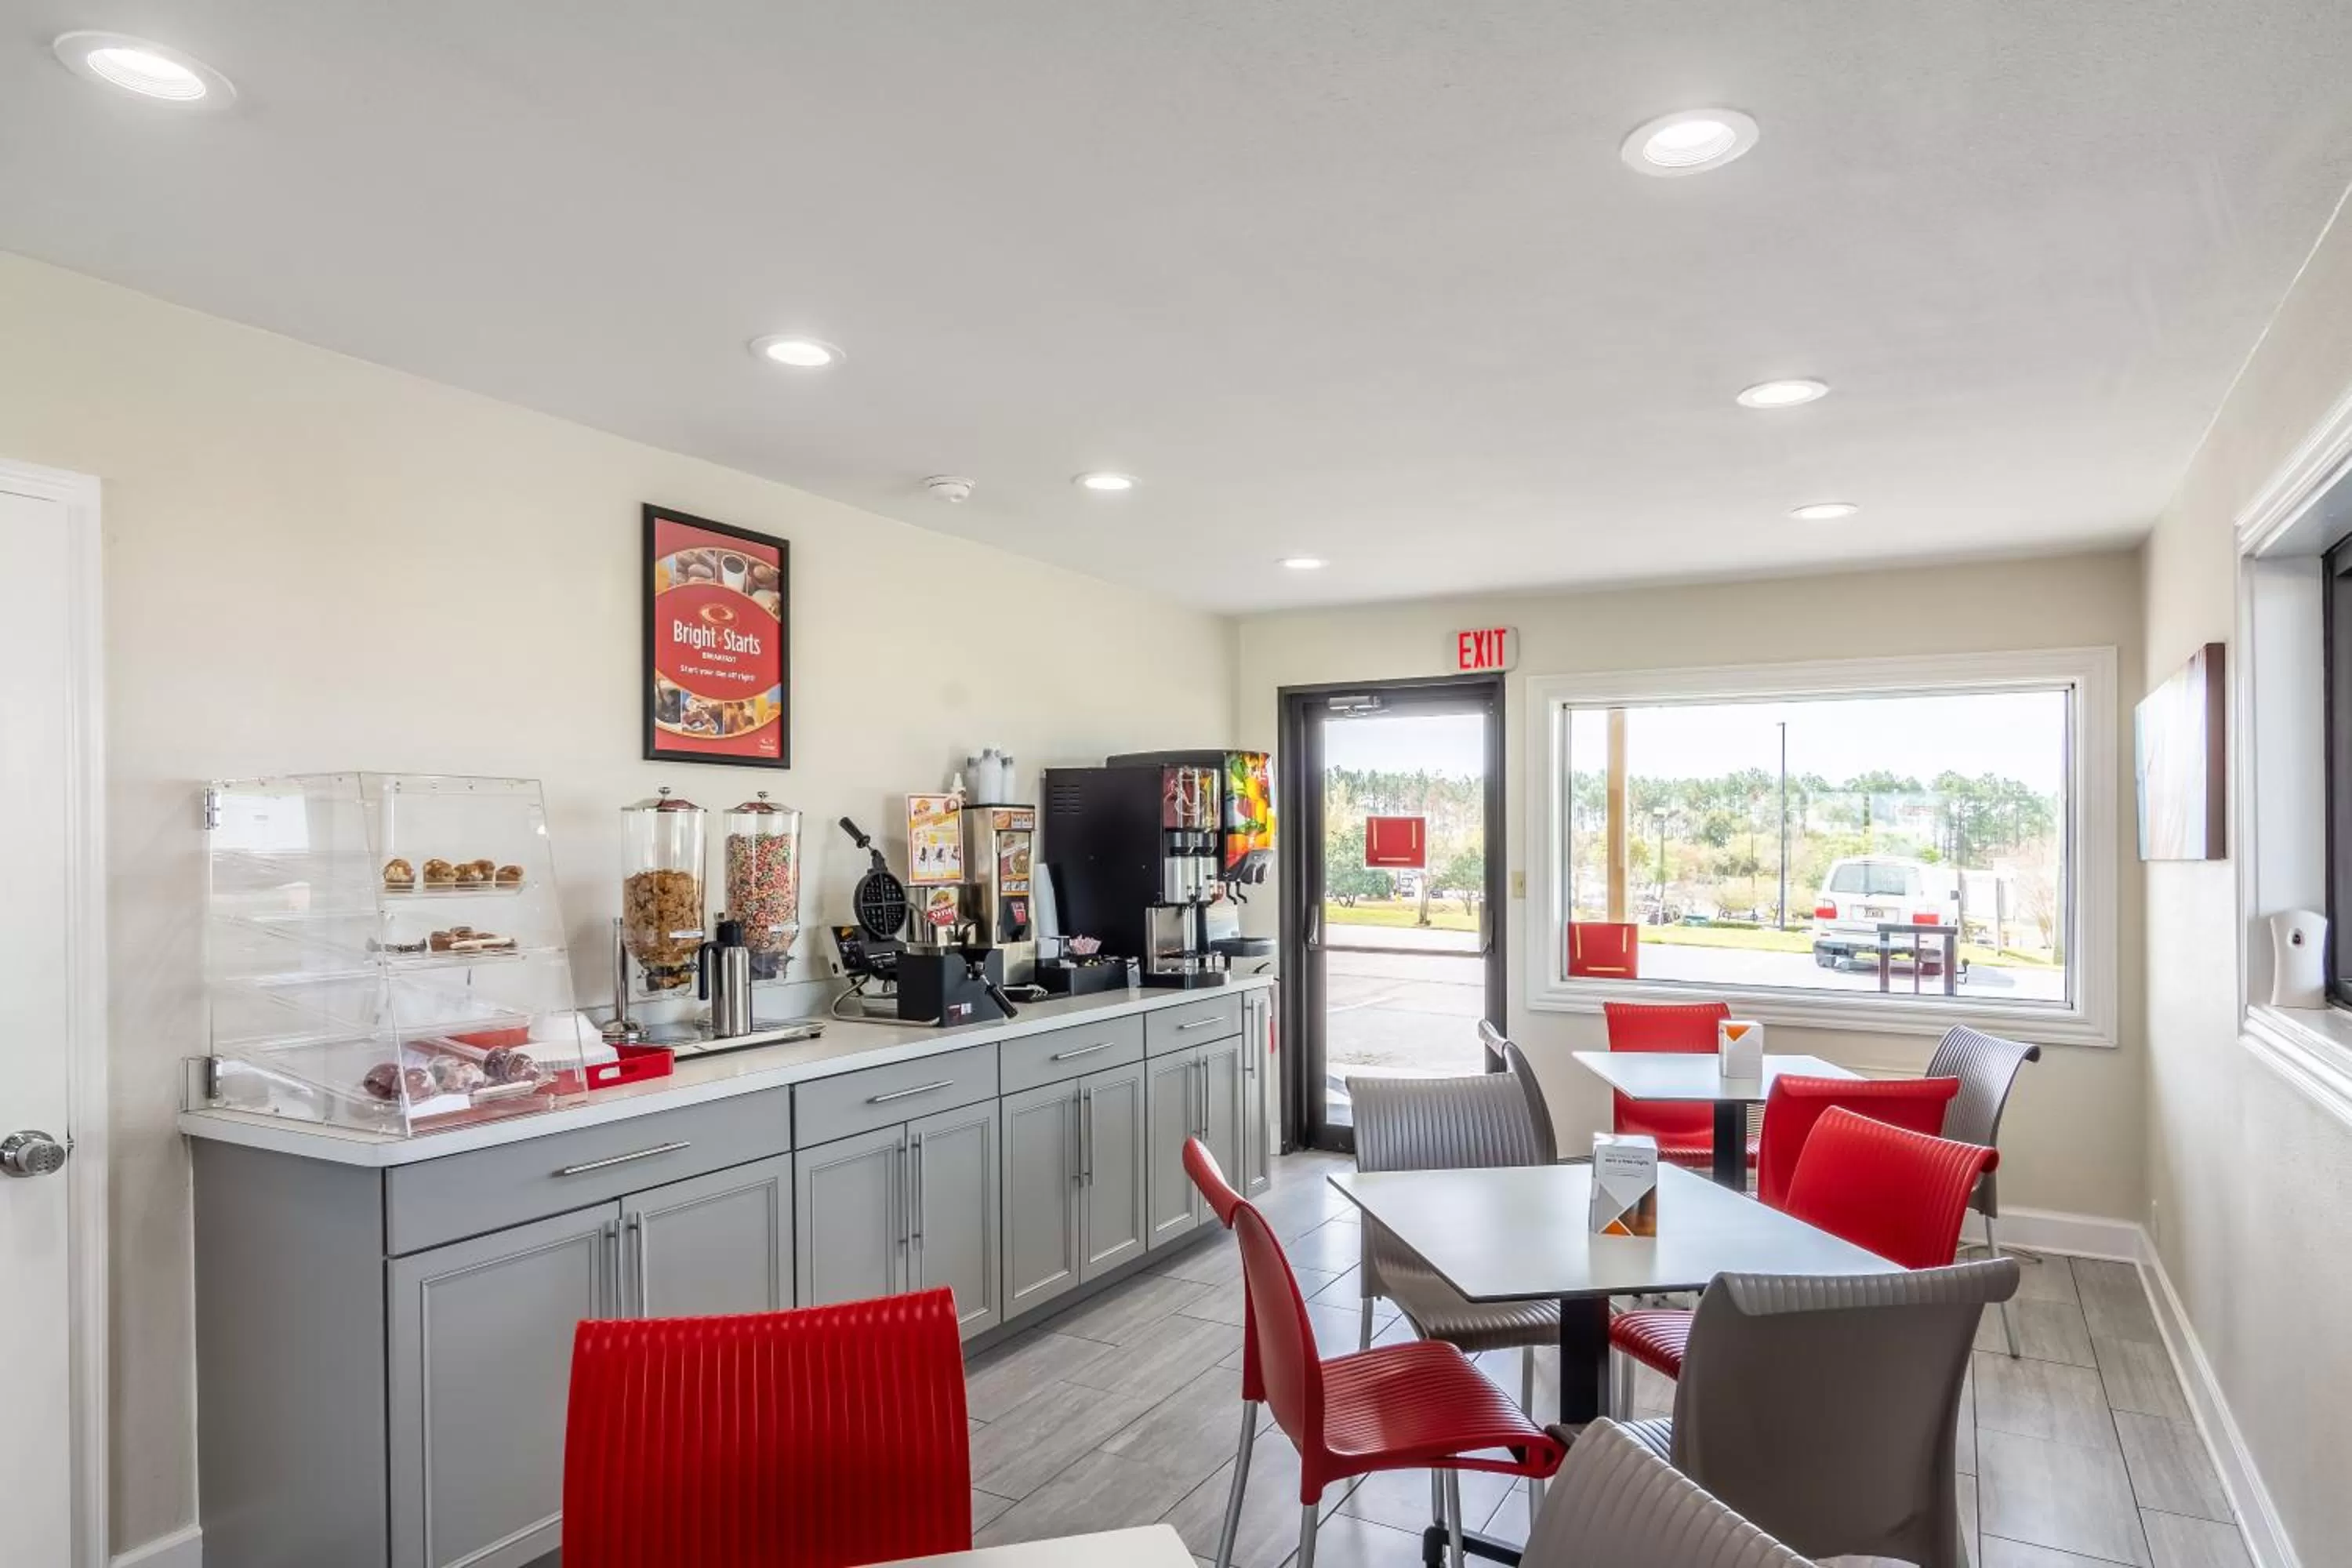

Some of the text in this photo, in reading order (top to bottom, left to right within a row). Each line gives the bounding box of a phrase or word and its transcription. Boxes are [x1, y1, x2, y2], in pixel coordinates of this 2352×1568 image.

[673, 619, 761, 655] Bright Starts
[1458, 628, 1506, 670] EXIT
